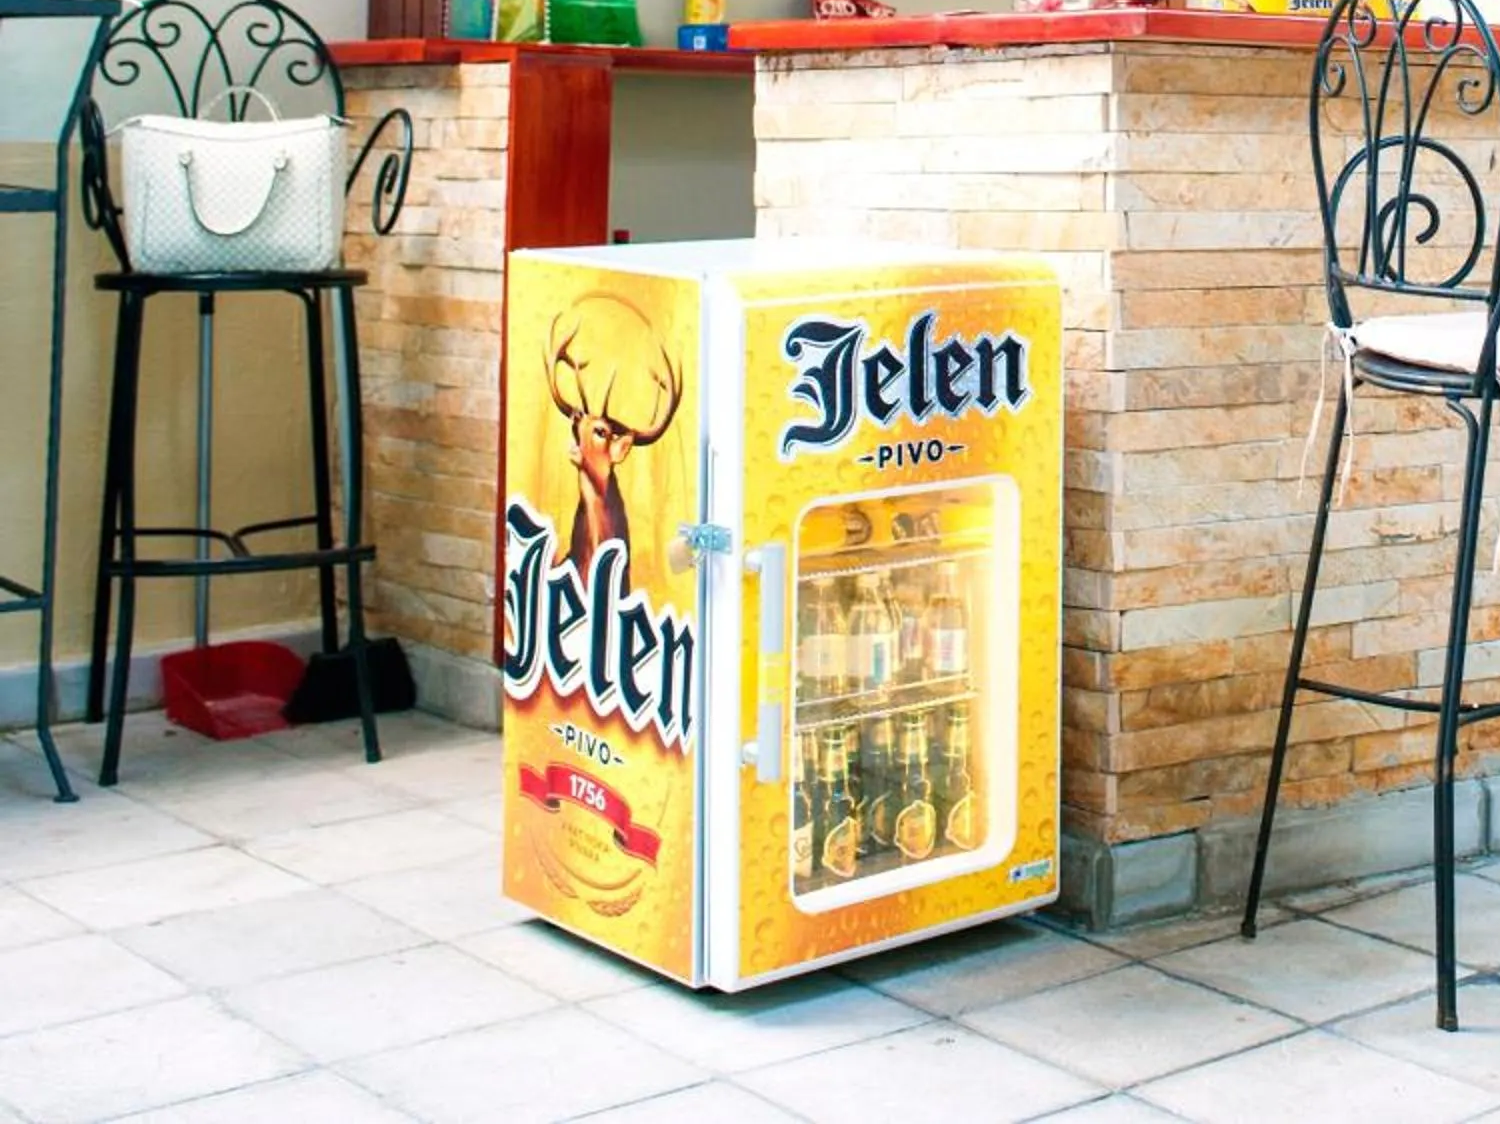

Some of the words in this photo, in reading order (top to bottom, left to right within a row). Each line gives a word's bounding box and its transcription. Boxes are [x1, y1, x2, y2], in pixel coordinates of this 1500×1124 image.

[782, 311, 1031, 456] Jelen
[504, 503, 694, 738] Jelen
[568, 774, 607, 812] 1756
